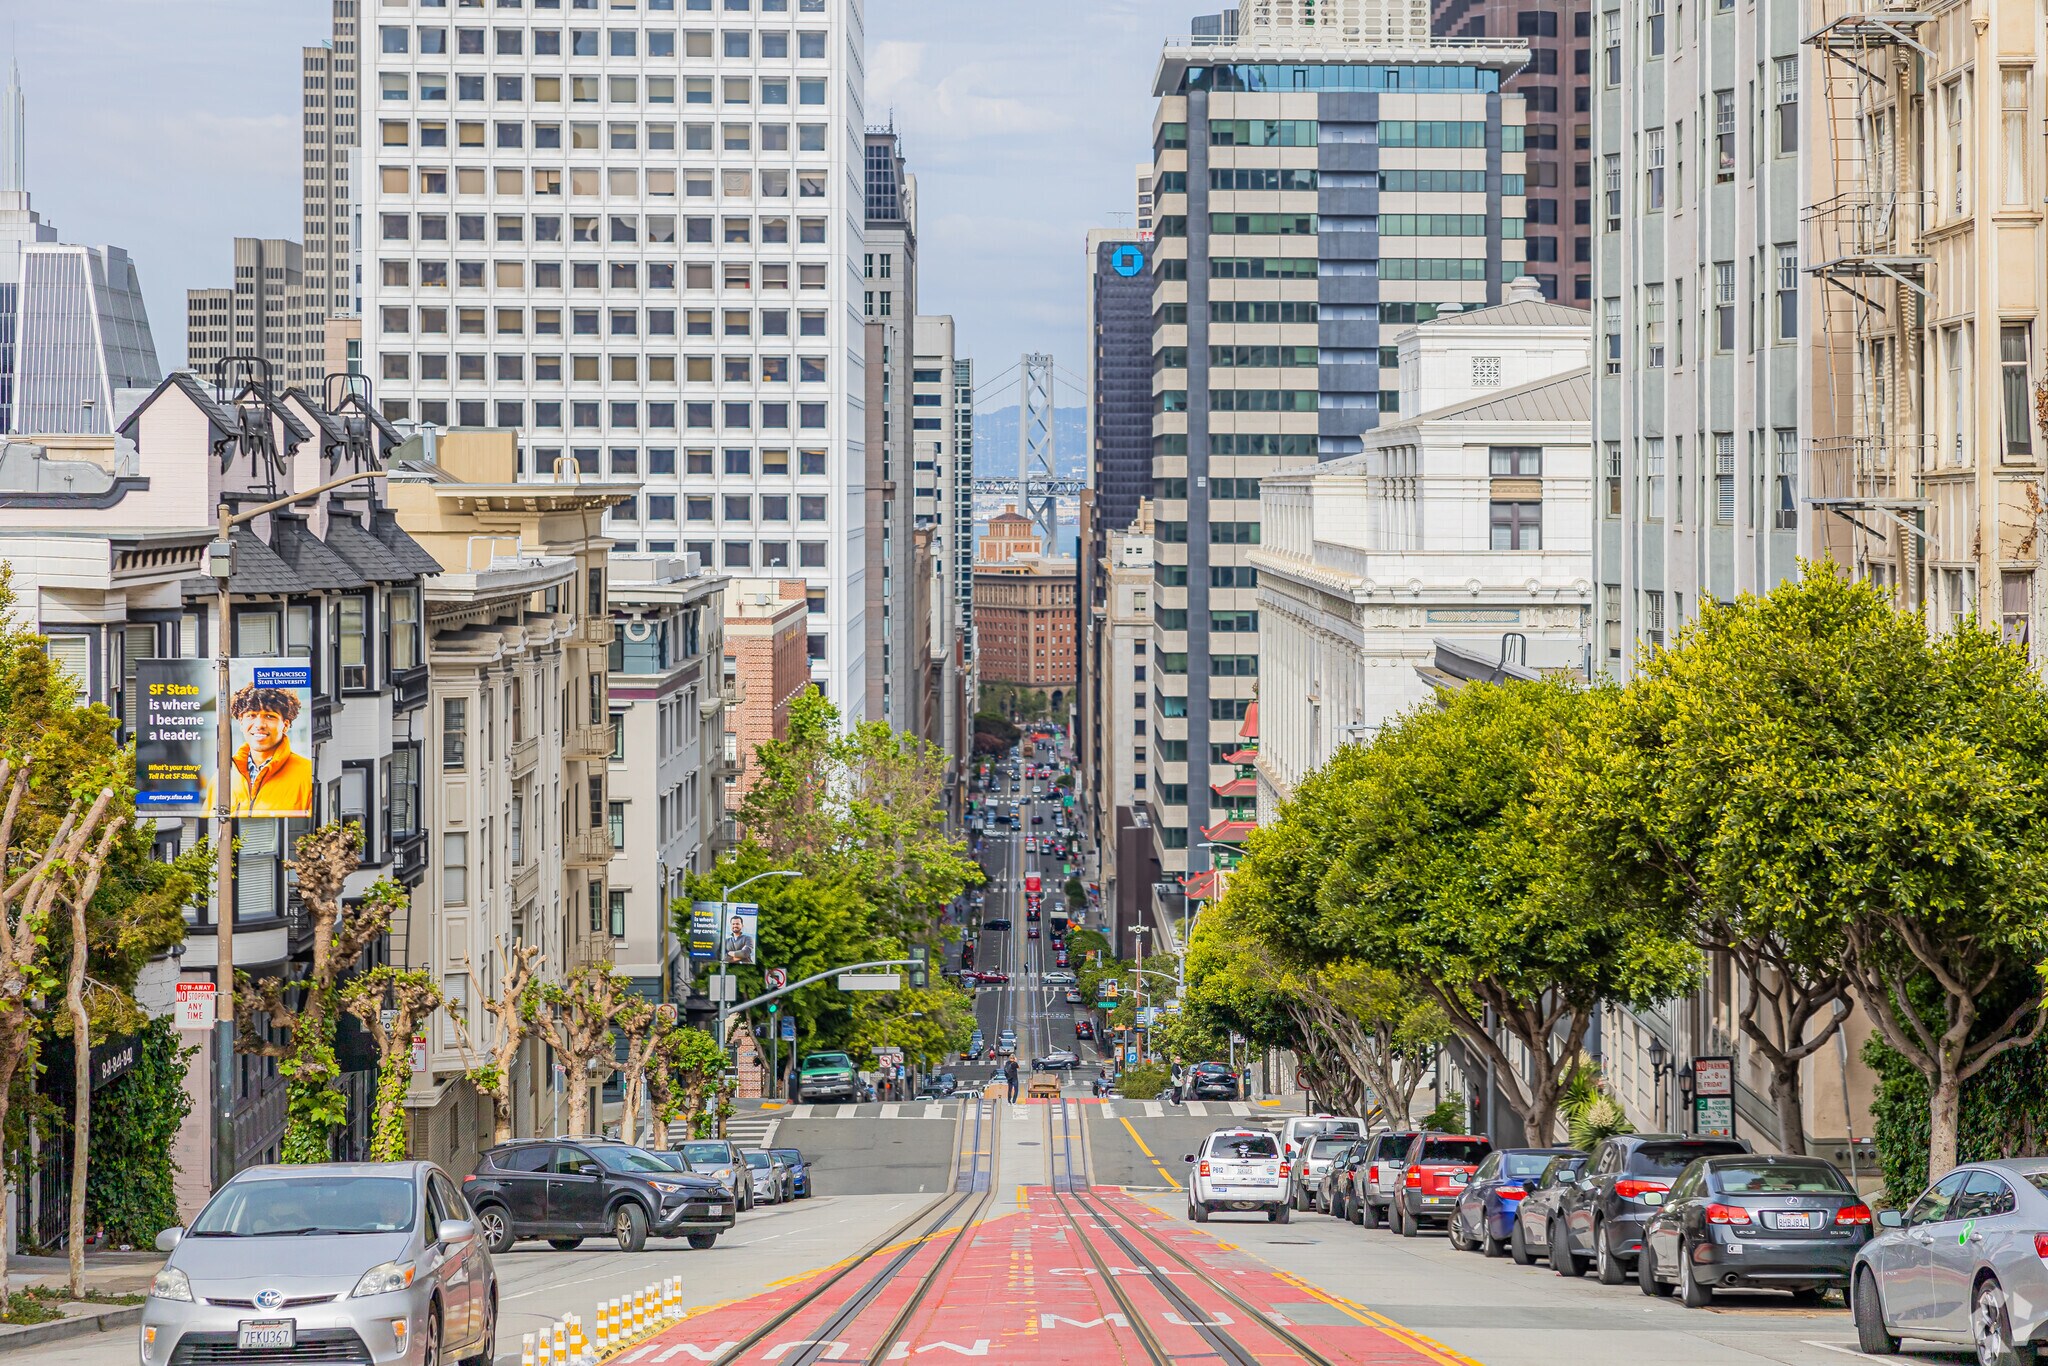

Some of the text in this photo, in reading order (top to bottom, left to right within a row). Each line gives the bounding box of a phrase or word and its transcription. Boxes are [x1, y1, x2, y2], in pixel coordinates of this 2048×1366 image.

[149, 684, 199, 695] SF State
[149, 698, 201, 710] is where
[149, 714, 204, 726] I became
[149, 729, 201, 741] a leader.
[184, 764, 202, 772] story?
[176, 991, 215, 1002] NO STOPPING
[188, 1002, 203, 1011] ANY
[187, 1011, 204, 1020] TIME
[1696, 1061, 1729, 1071] NO PARKING
[1699, 1072, 1704, 1080] 7
[1714, 1071, 1720, 1080] 8
[1699, 1099, 1706, 1110] 2
[1700, 1111, 1706, 1119] 8
[1717, 1110, 1723, 1119] 9
[244, 1330, 289, 1343] 7EKU367
